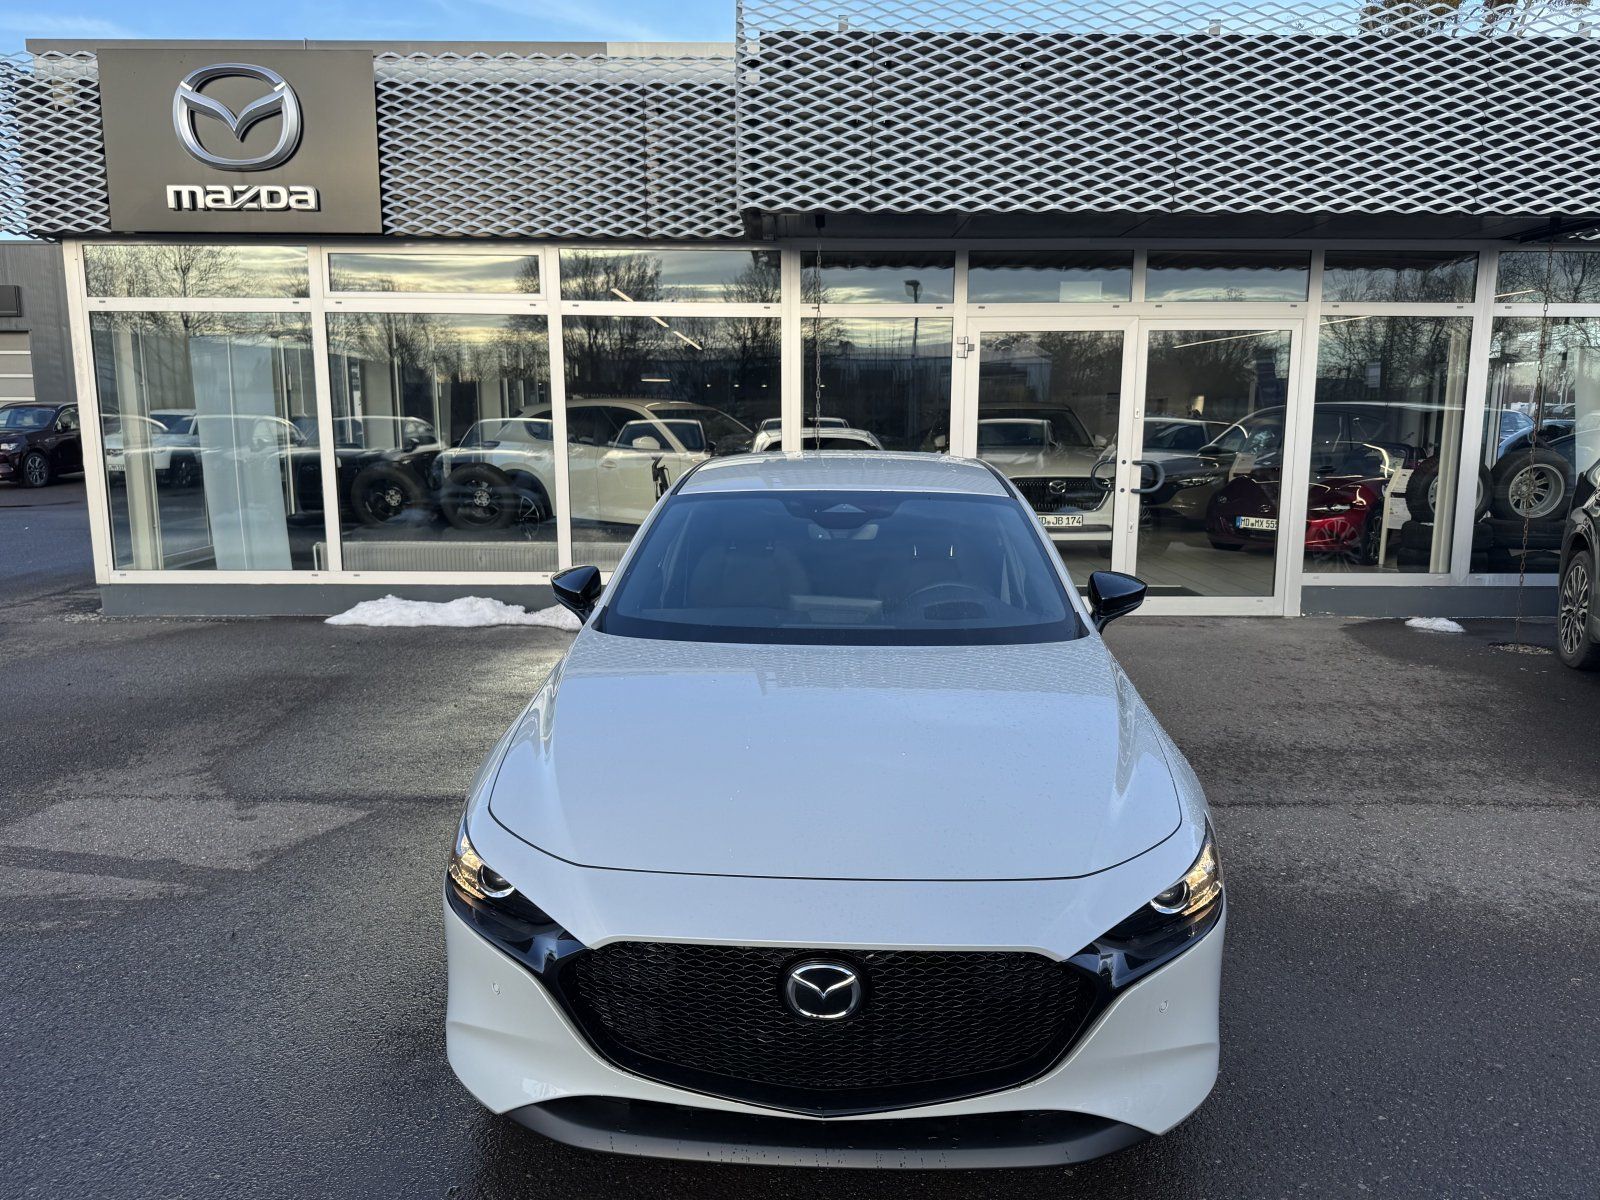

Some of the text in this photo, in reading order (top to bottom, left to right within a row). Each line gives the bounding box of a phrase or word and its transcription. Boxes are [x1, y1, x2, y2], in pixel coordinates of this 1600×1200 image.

[1051, 516, 1064, 525] JB
[1065, 516, 1082, 525] 174
[1240, 517, 1250, 527] MD
[1254, 519, 1264, 528] MX
